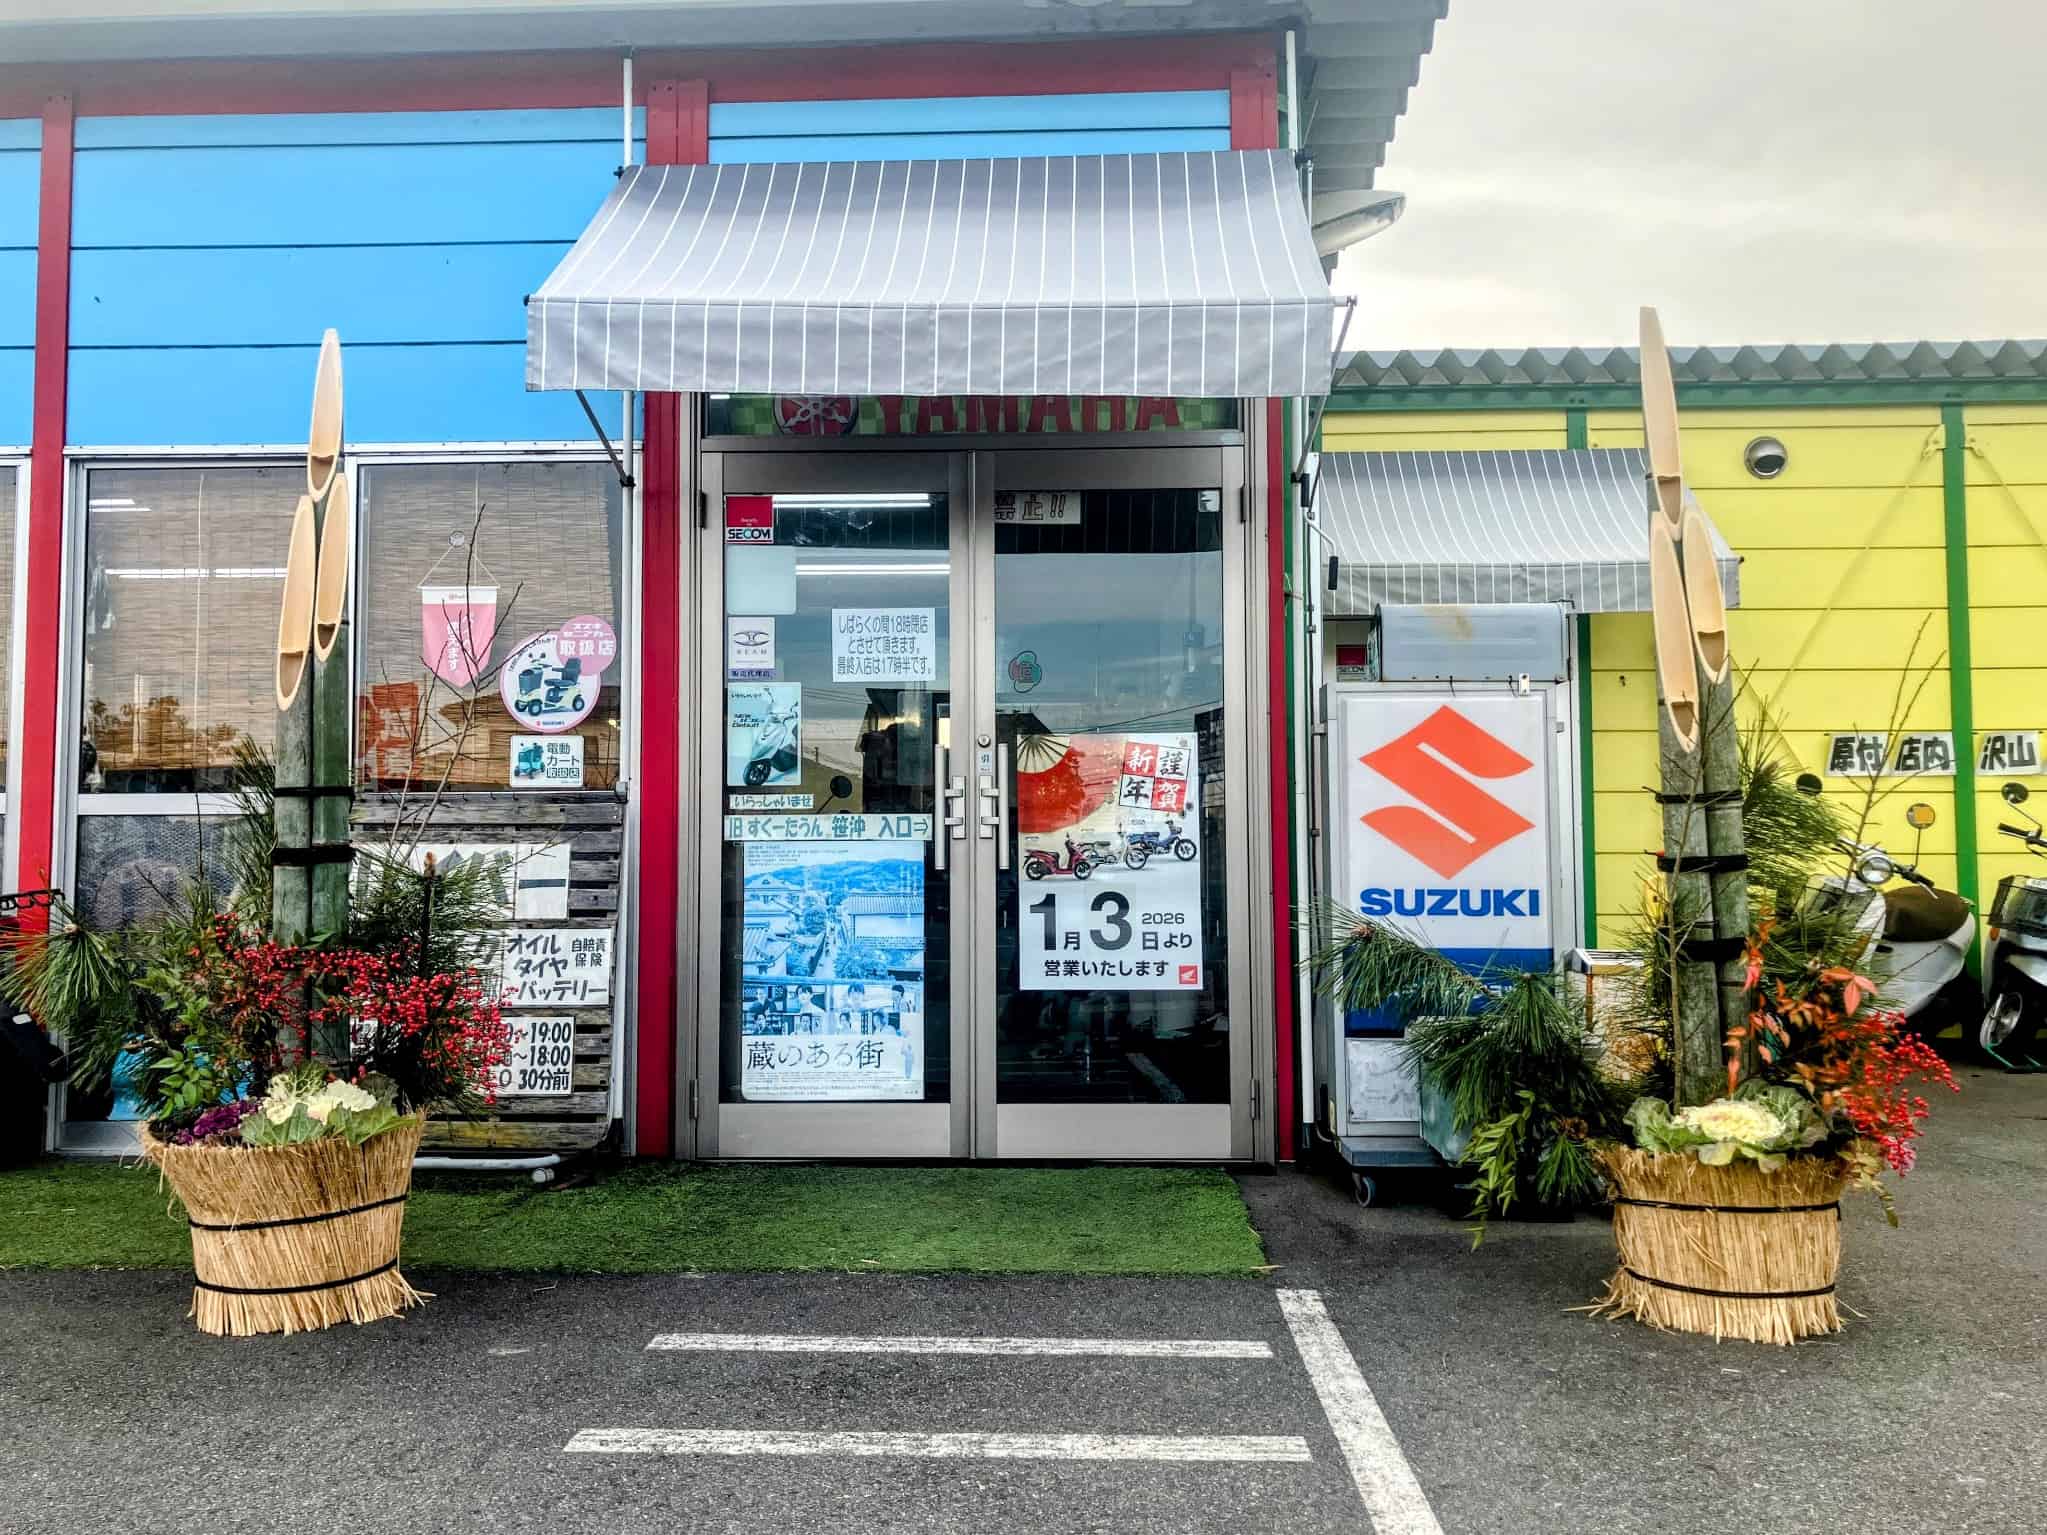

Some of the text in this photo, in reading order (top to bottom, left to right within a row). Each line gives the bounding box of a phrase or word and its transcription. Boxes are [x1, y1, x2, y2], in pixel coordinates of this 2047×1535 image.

[728, 528, 770, 539] SECOM
[839, 615, 929, 634] しばらくの間18時閉店
[848, 636, 921, 655] とさせて頂きます。
[837, 657, 931, 675] 最終入店は17時半です。
[546, 755, 579, 767] カート
[1830, 735, 2037, 772] 原付 店内 沢山
[878, 816, 912, 838] 入口
[1360, 888, 1540, 917] SUZUKI
[1141, 912, 1185, 925] 2026
[507, 934, 561, 955] オイル
[513, 957, 568, 978] タイヤ
[575, 953, 602, 968] 保険
[1044, 960, 1169, 977] 営業いたします
[517, 979, 608, 1001] バッテリー
[747, 1040, 885, 1070] 蔵のある街
